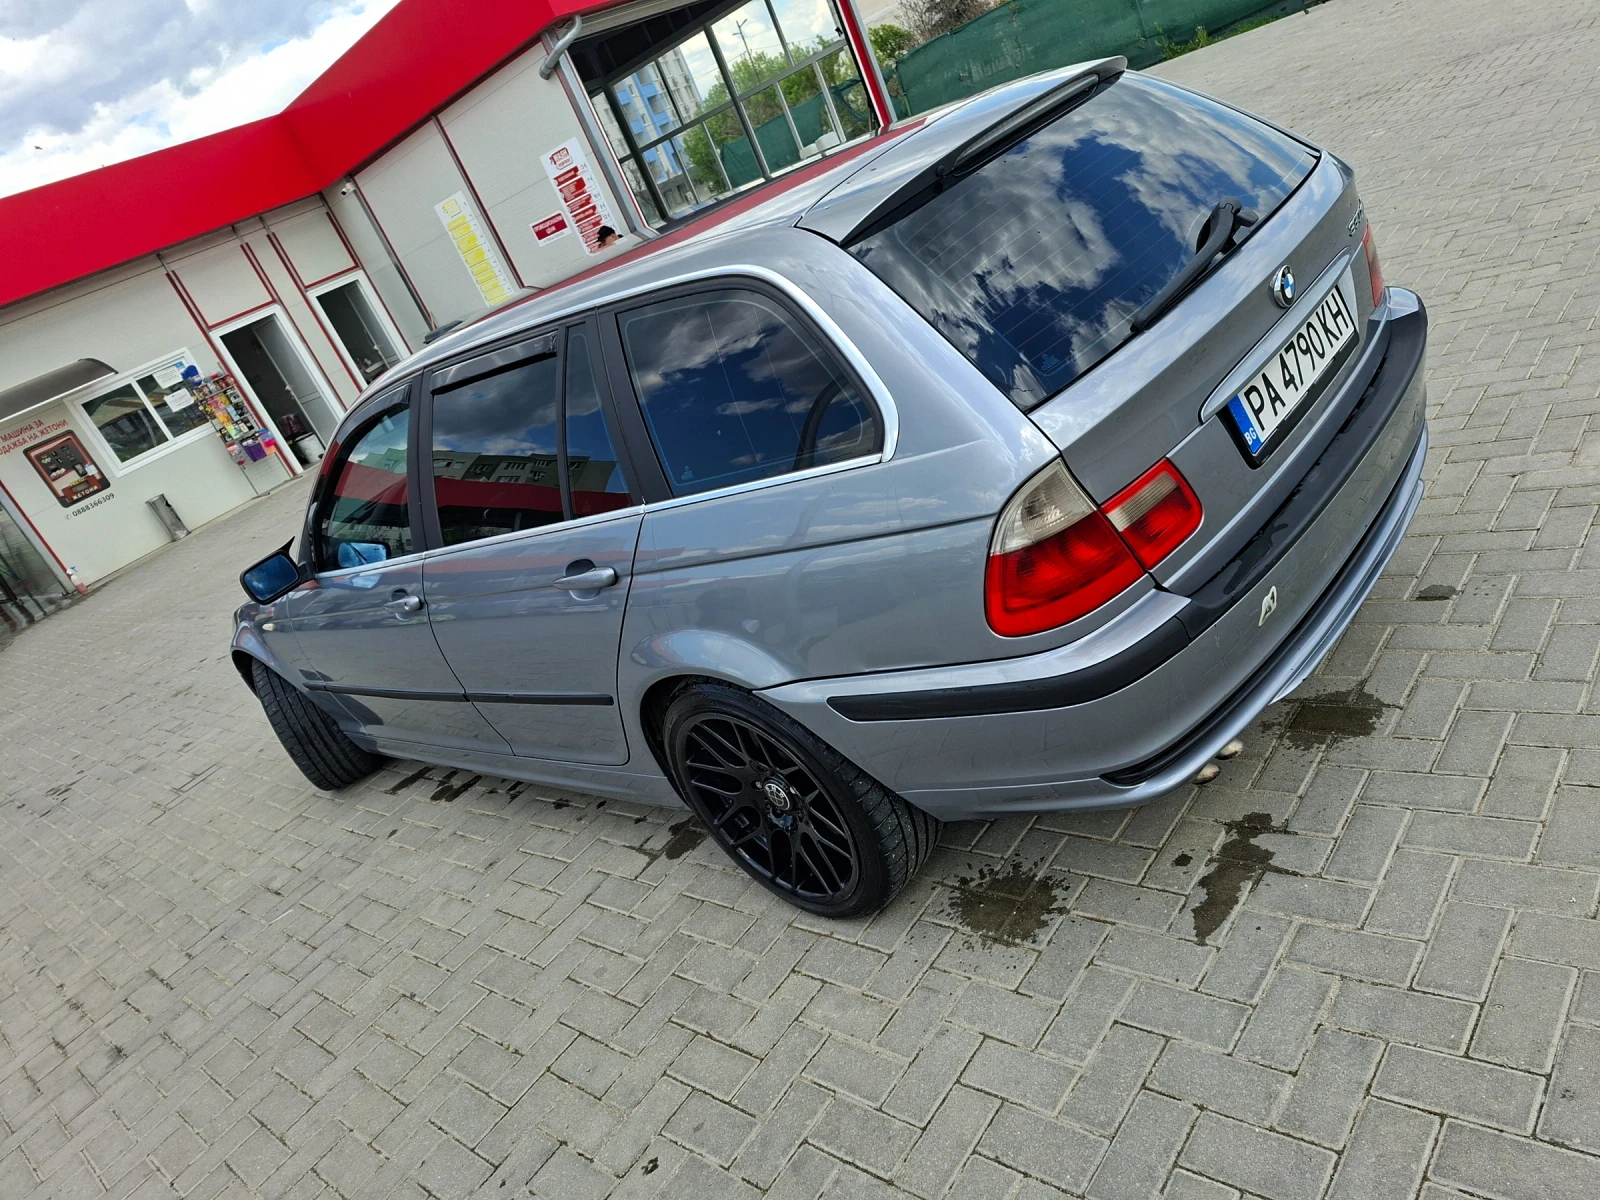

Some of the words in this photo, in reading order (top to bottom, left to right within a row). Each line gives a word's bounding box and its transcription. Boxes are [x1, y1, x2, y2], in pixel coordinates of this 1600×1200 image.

[1244, 372, 1286, 431] PA
[1278, 321, 1326, 392] 4790
[1315, 292, 1349, 348] KH
[0, 423, 35, 443] МАШИНА
[33, 419, 45, 428] ЗА
[27, 432, 39, 442] НА
[37, 419, 68, 437] ЖЕТОНИ
[1244, 426, 1257, 446] BG
[72, 485, 98, 500] ЖЕТОНИ
[72, 492, 115, 517] 0888366309
